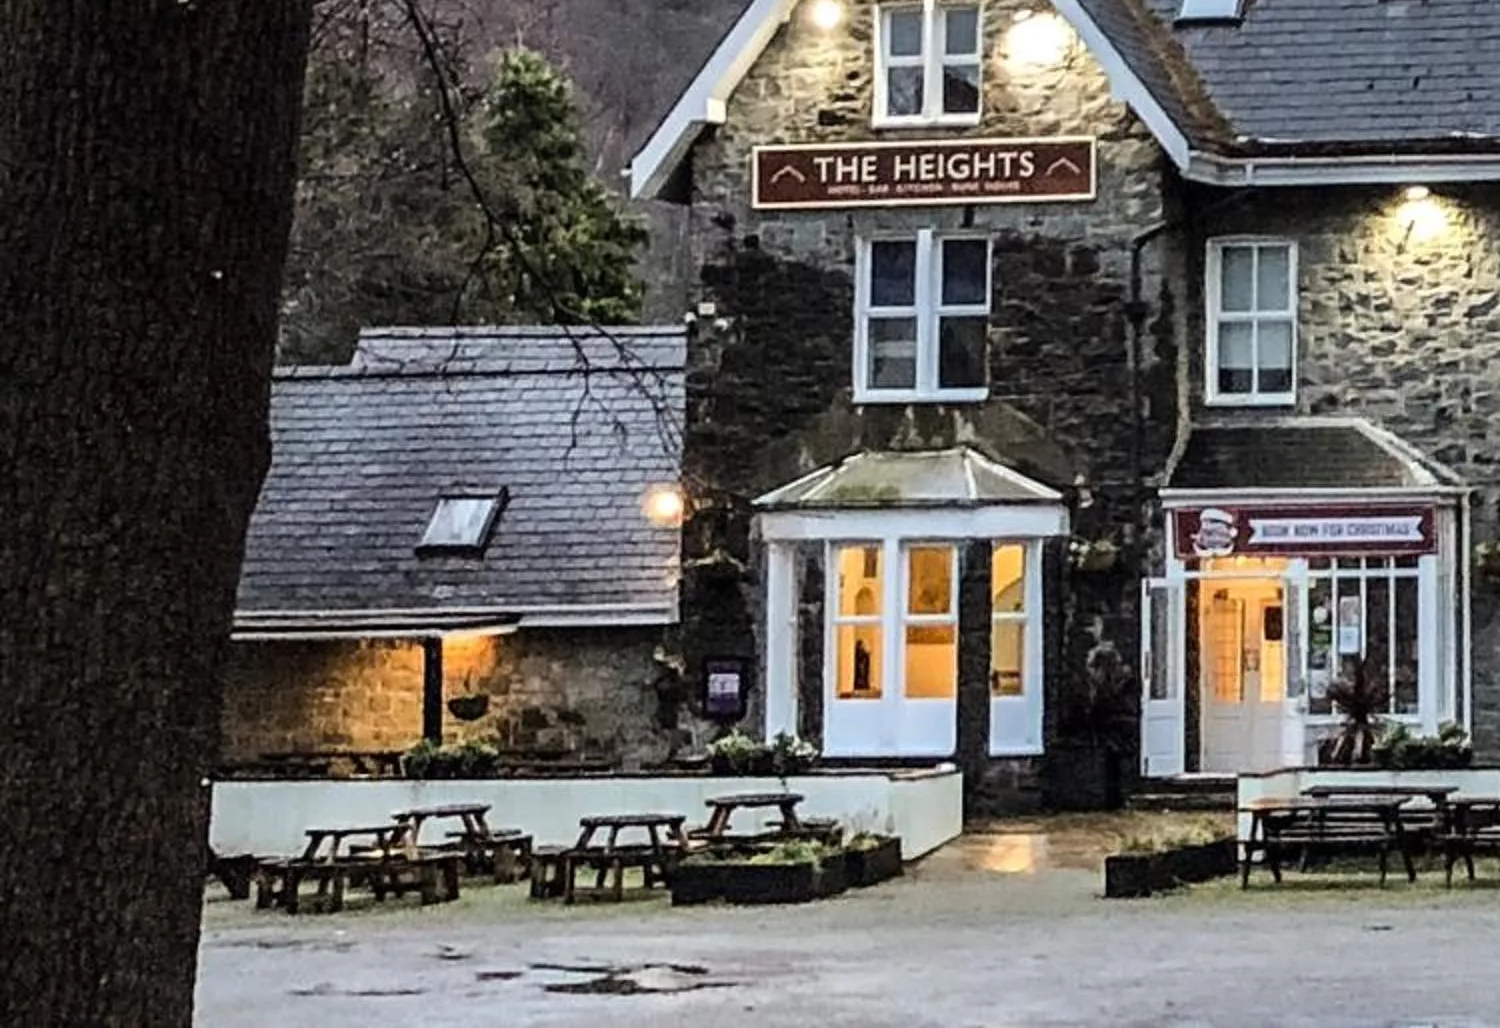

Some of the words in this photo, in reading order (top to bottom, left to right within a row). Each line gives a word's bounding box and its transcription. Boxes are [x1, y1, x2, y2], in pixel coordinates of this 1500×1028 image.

[813, 154, 878, 183] THE
[893, 150, 1036, 181] HEIGHTS
[1347, 522, 1410, 536] CHRISTMAS
